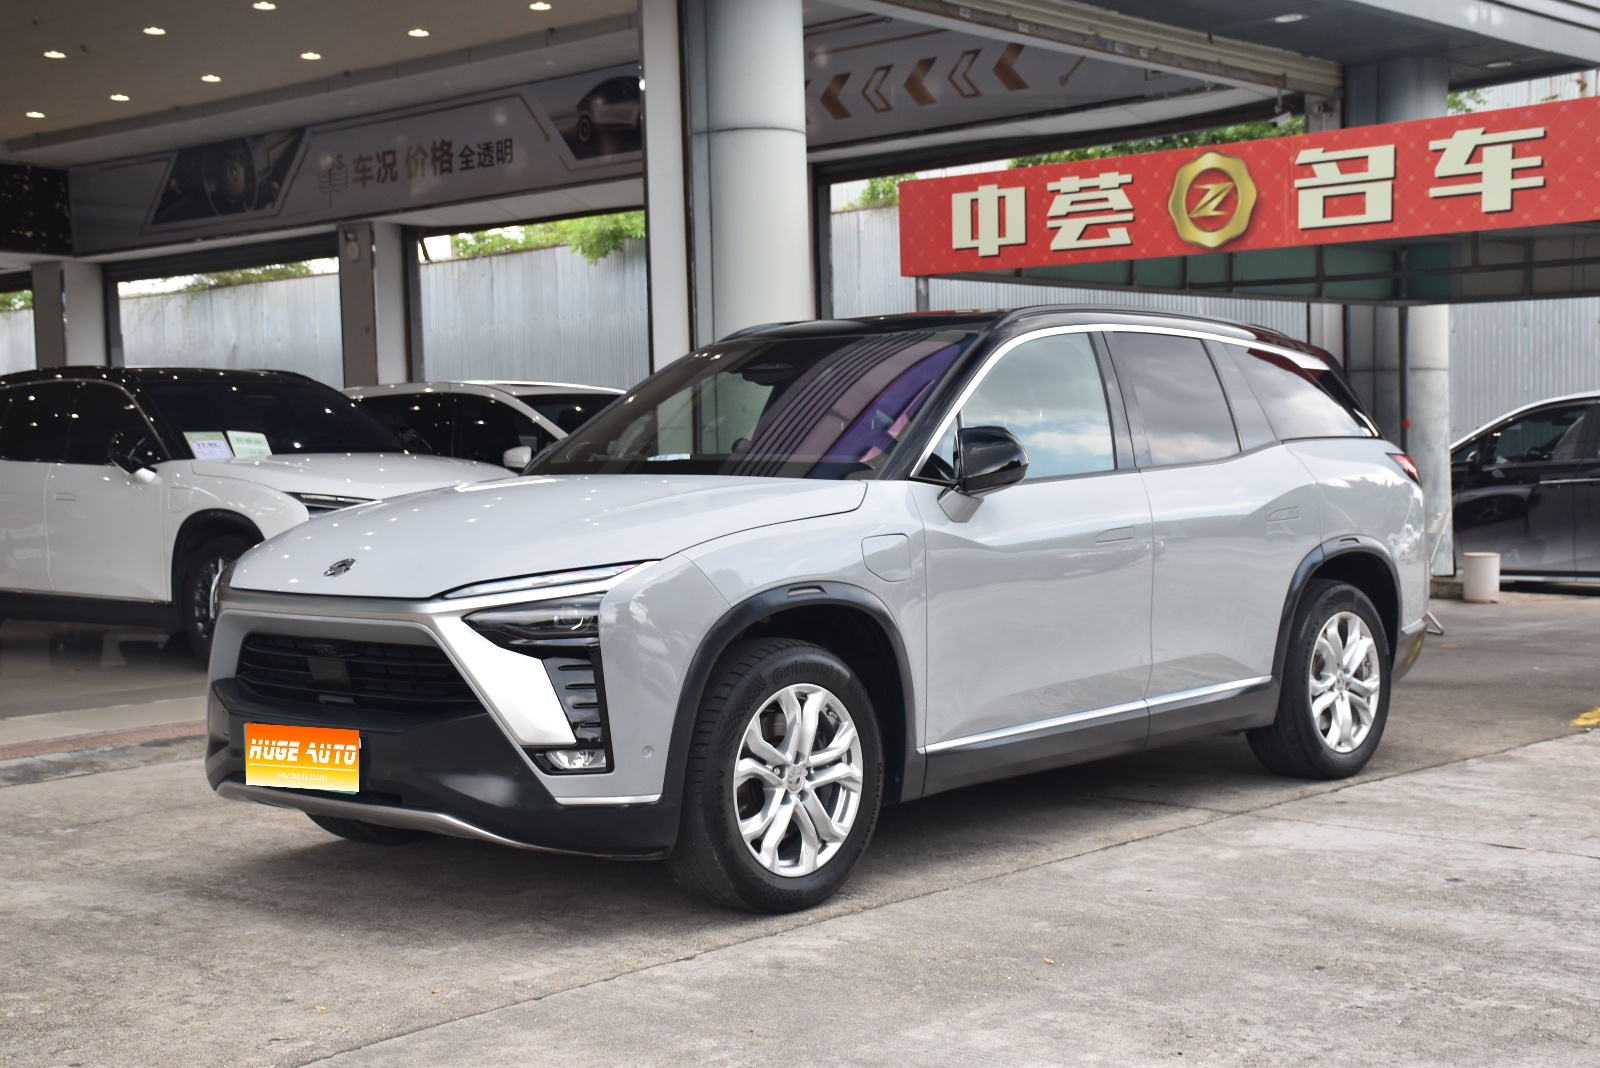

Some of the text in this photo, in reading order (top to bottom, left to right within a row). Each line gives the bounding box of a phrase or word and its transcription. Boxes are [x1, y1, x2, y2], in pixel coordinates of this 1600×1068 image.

[352, 137, 514, 188] 车况 价格 全透明
[951, 171, 1135, 257] 中荟
[1294, 126, 1547, 230] 名车
[772, 660, 834, 685] Continental
